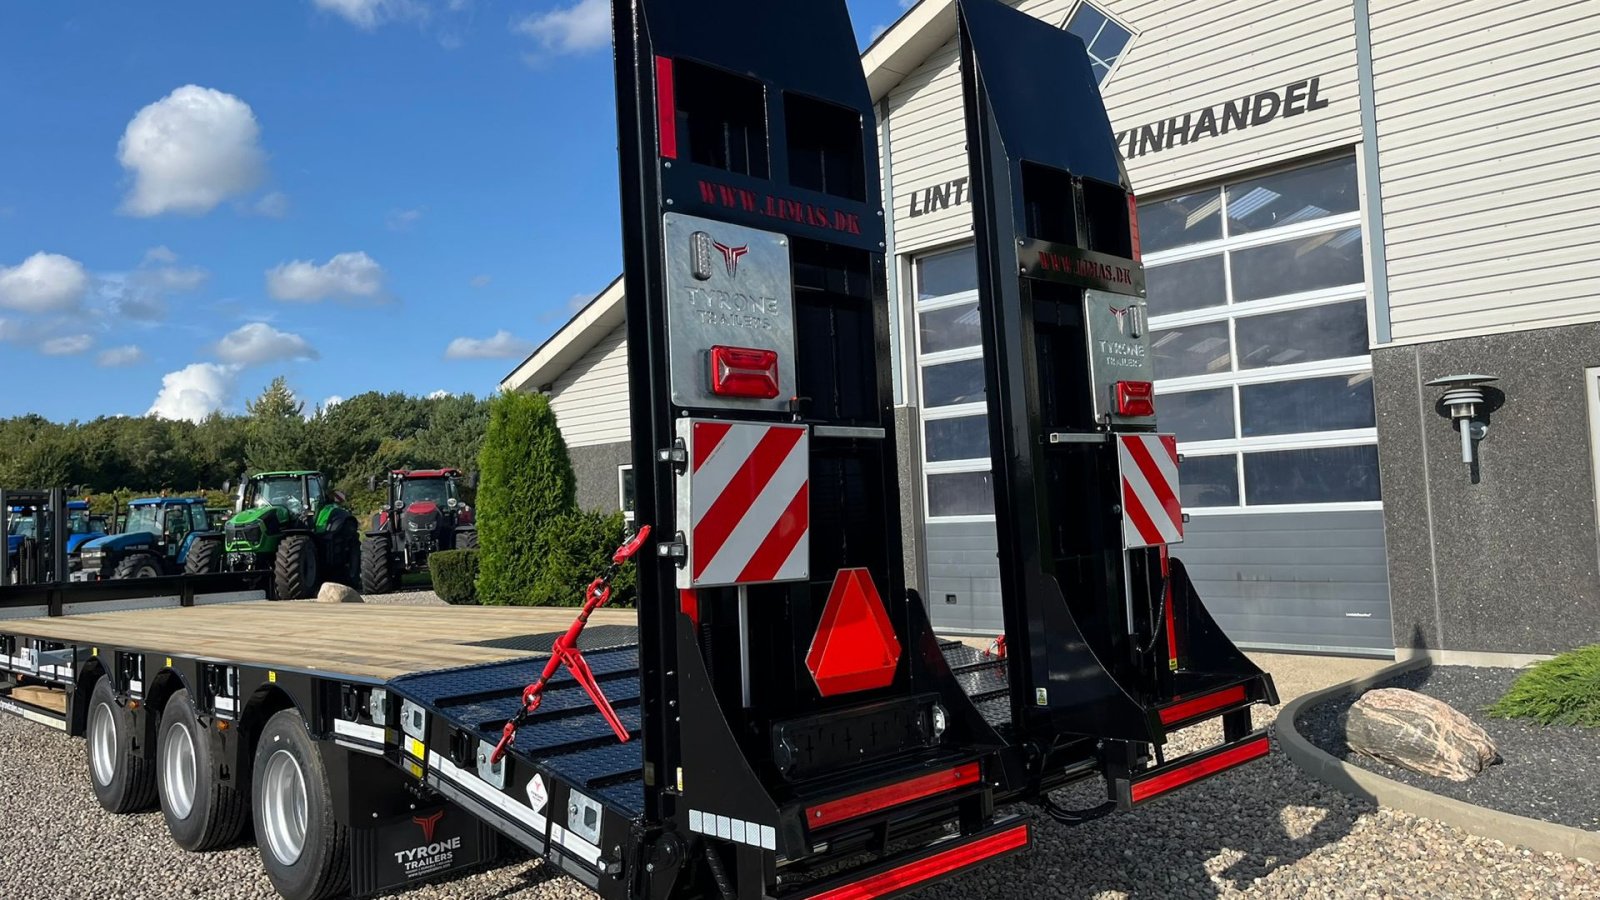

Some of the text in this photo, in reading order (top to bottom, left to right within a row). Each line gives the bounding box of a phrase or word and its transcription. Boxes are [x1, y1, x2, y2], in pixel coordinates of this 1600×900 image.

[698, 180, 862, 235] WWW.LIMAS.DK
[1039, 251, 1133, 285] WWW.LIMAS.DK
[684, 285, 779, 317] TYRONE
[696, 309, 772, 331] TRAILERS
[1097, 338, 1145, 357] TYRONE
[394, 836, 461, 864] TYRONE
[404, 851, 453, 870] TRAILERS
